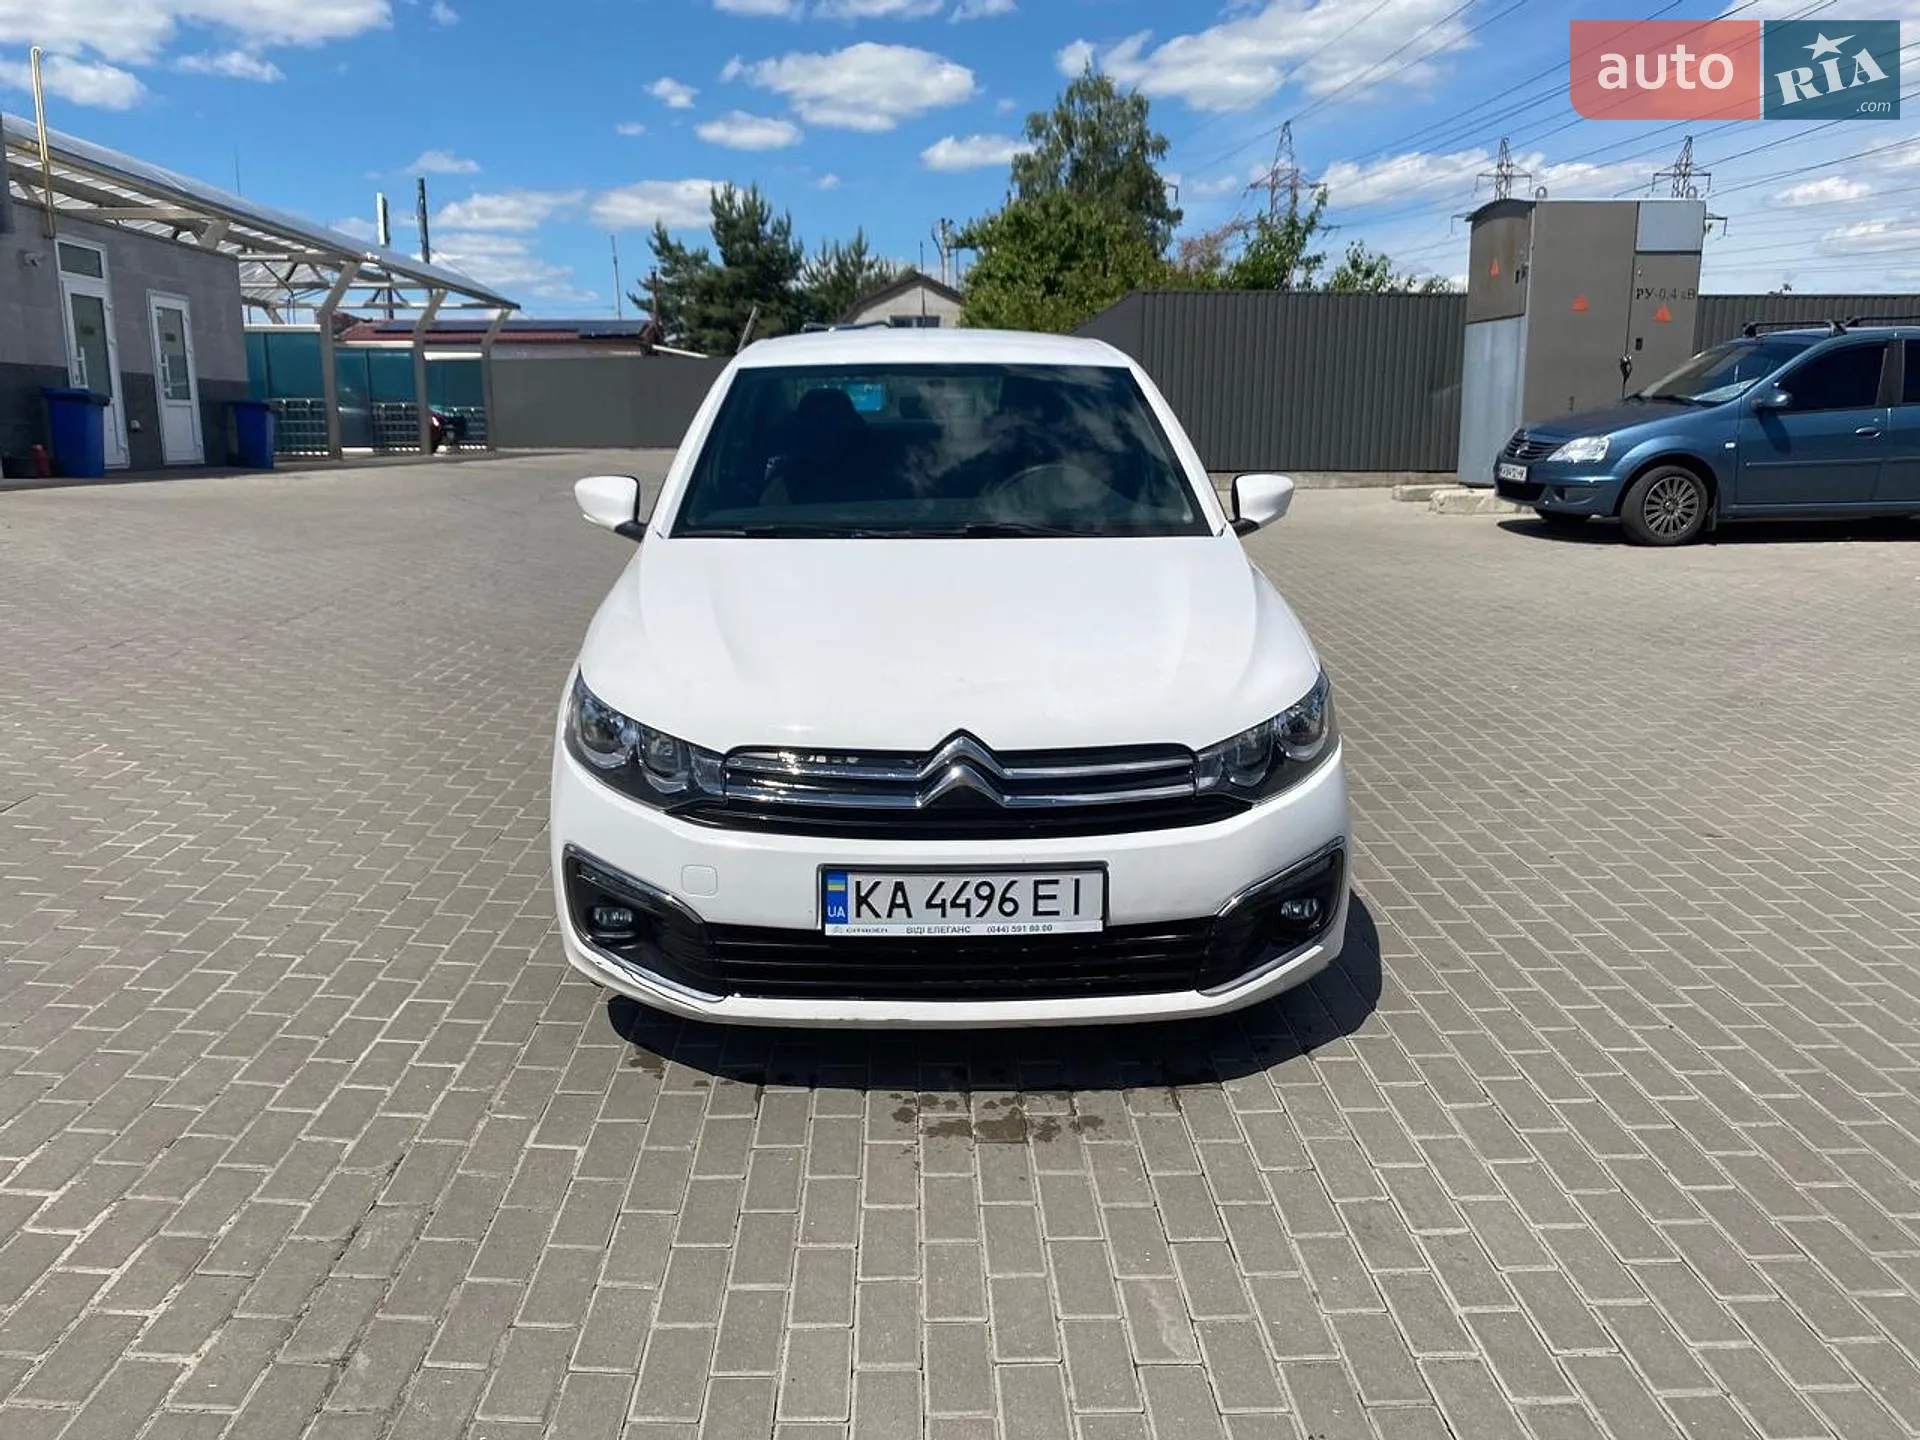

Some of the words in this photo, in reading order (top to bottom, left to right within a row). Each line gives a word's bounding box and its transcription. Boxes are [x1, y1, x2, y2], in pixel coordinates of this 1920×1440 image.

[855, 880, 913, 918] KA
[925, 879, 1020, 918] 4496
[1032, 877, 1081, 916] EI
[828, 905, 846, 918] UA
[927, 923, 971, 934] ЕЛЕГАНС
